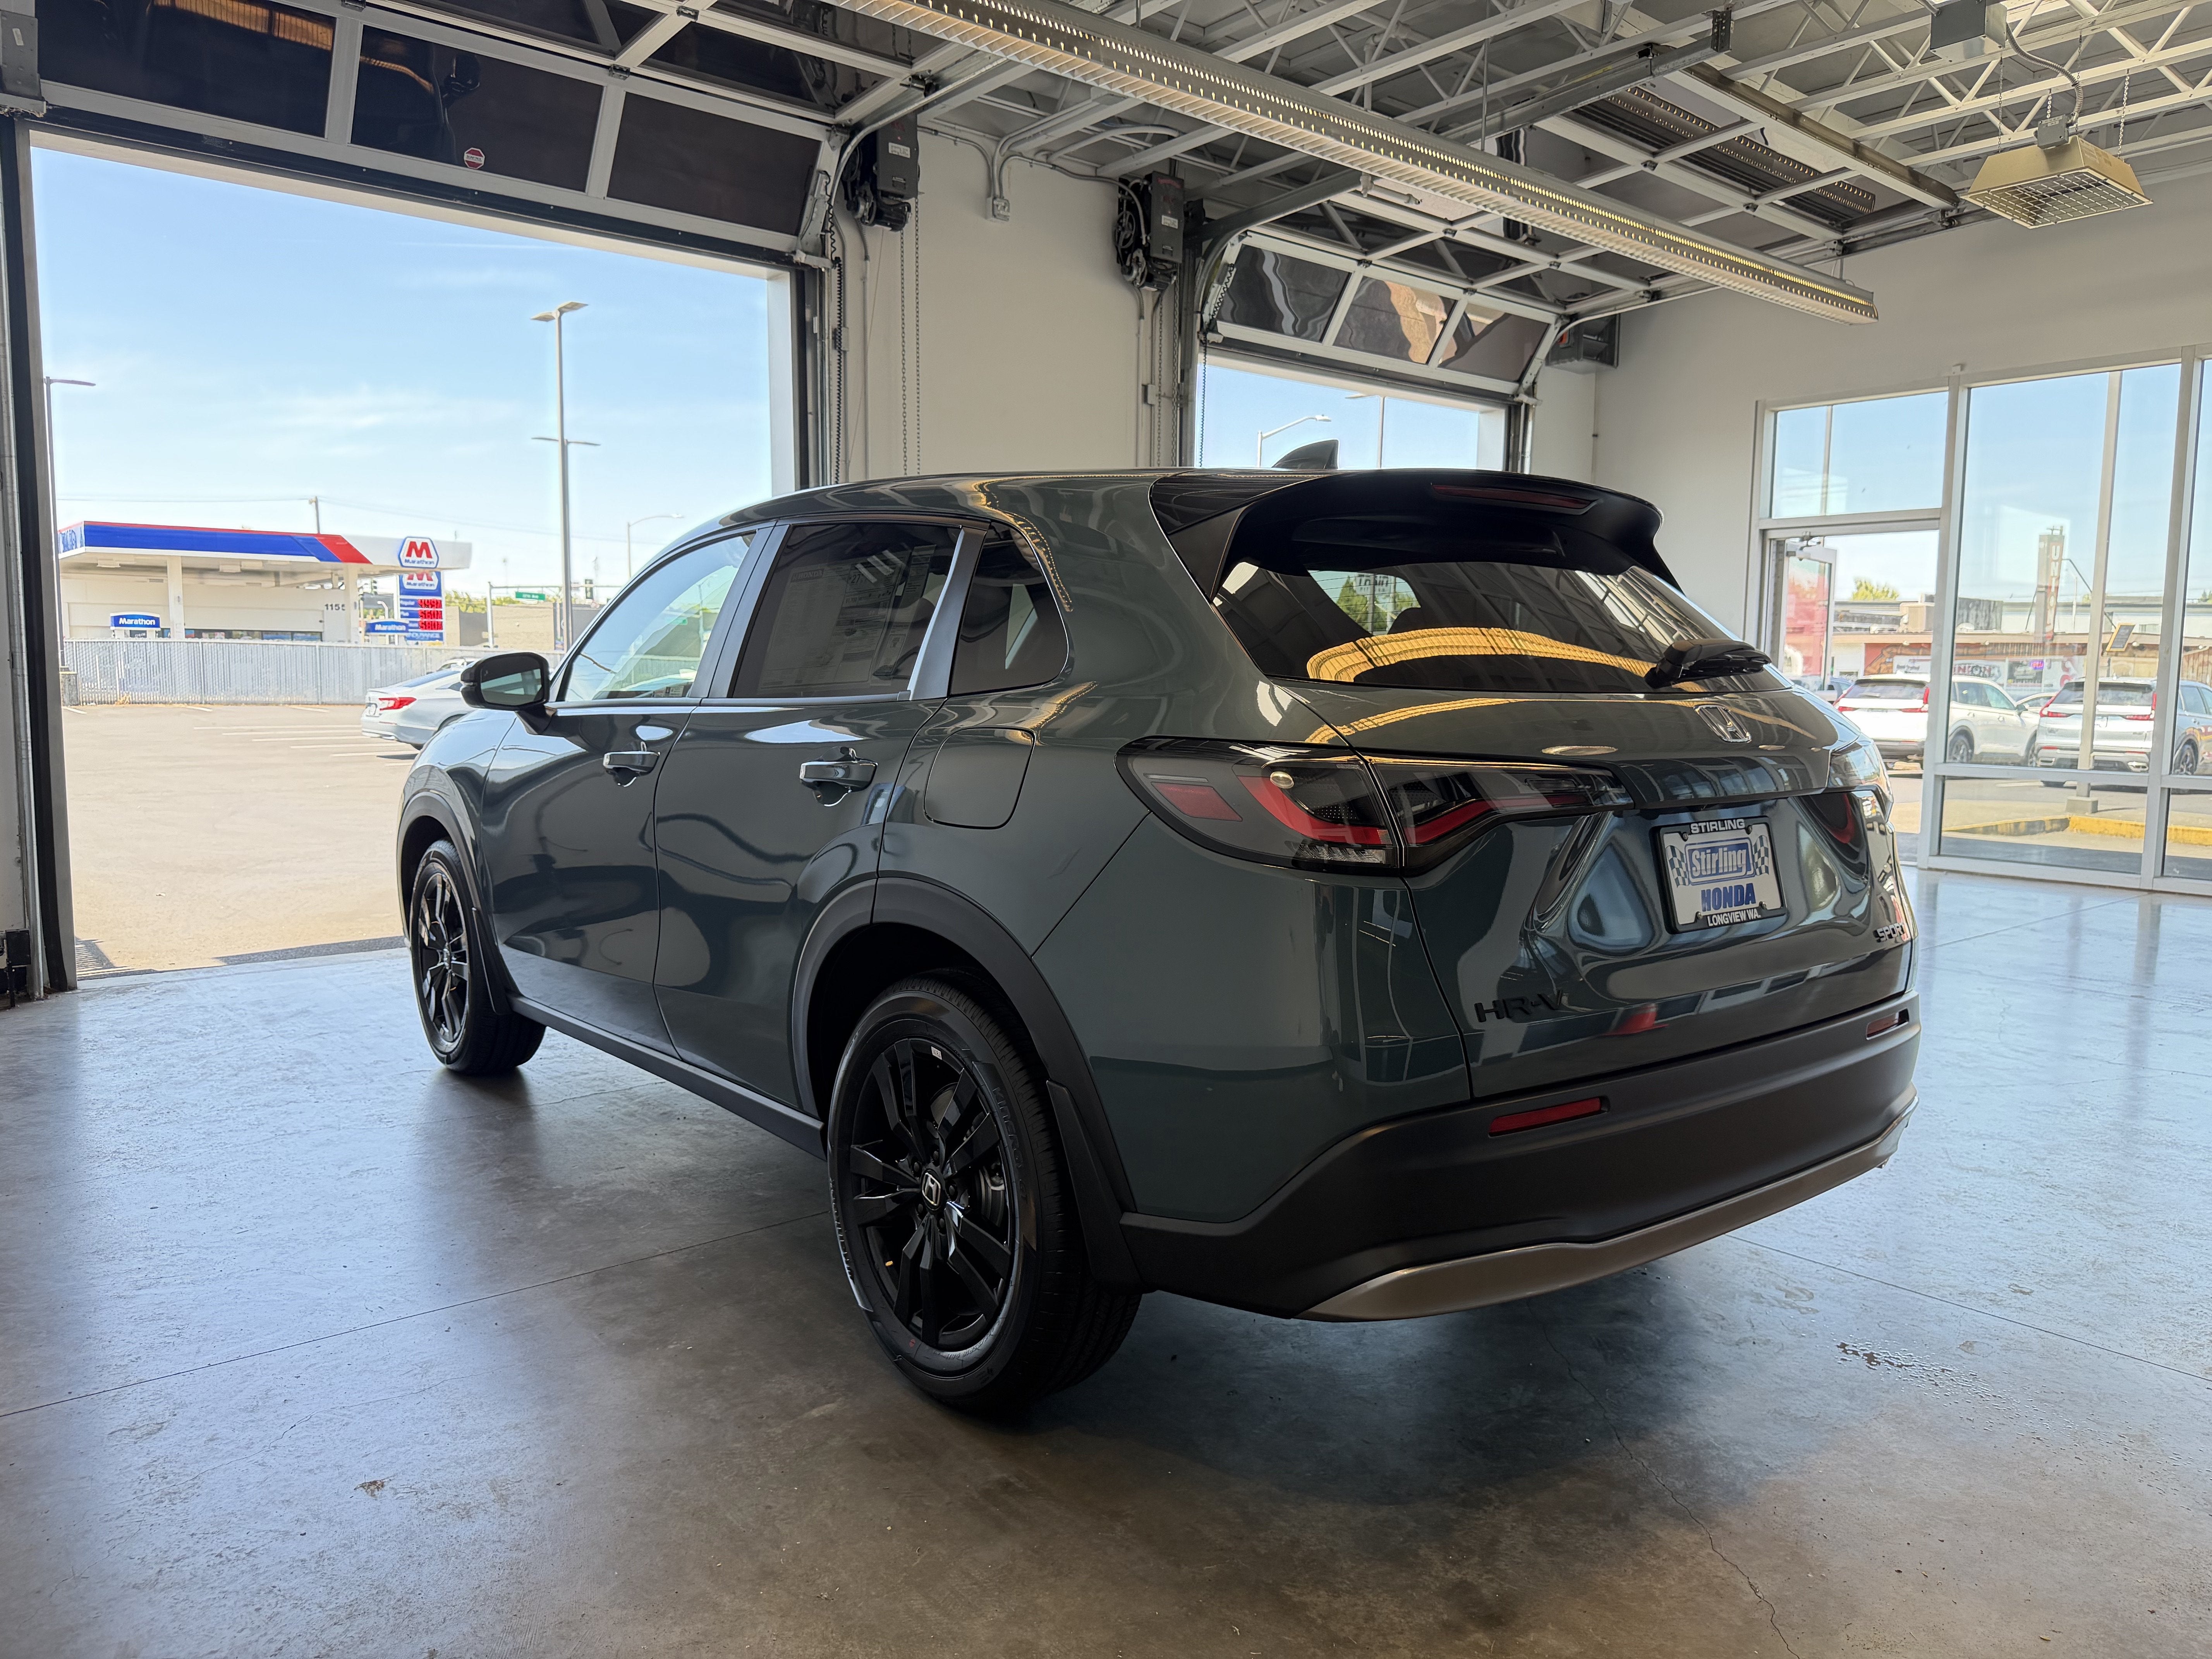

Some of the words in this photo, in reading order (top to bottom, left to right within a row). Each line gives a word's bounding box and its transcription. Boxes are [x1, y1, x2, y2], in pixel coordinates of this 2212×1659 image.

[406, 541, 433, 558] M
[1690, 818, 1745, 834] STIRLING
[1691, 847, 1747, 877] Stirling
[1701, 883, 1756, 912] HONDA
[1707, 912, 1747, 927] LONGVIEW
[1474, 989, 1563, 1023] HR-V
